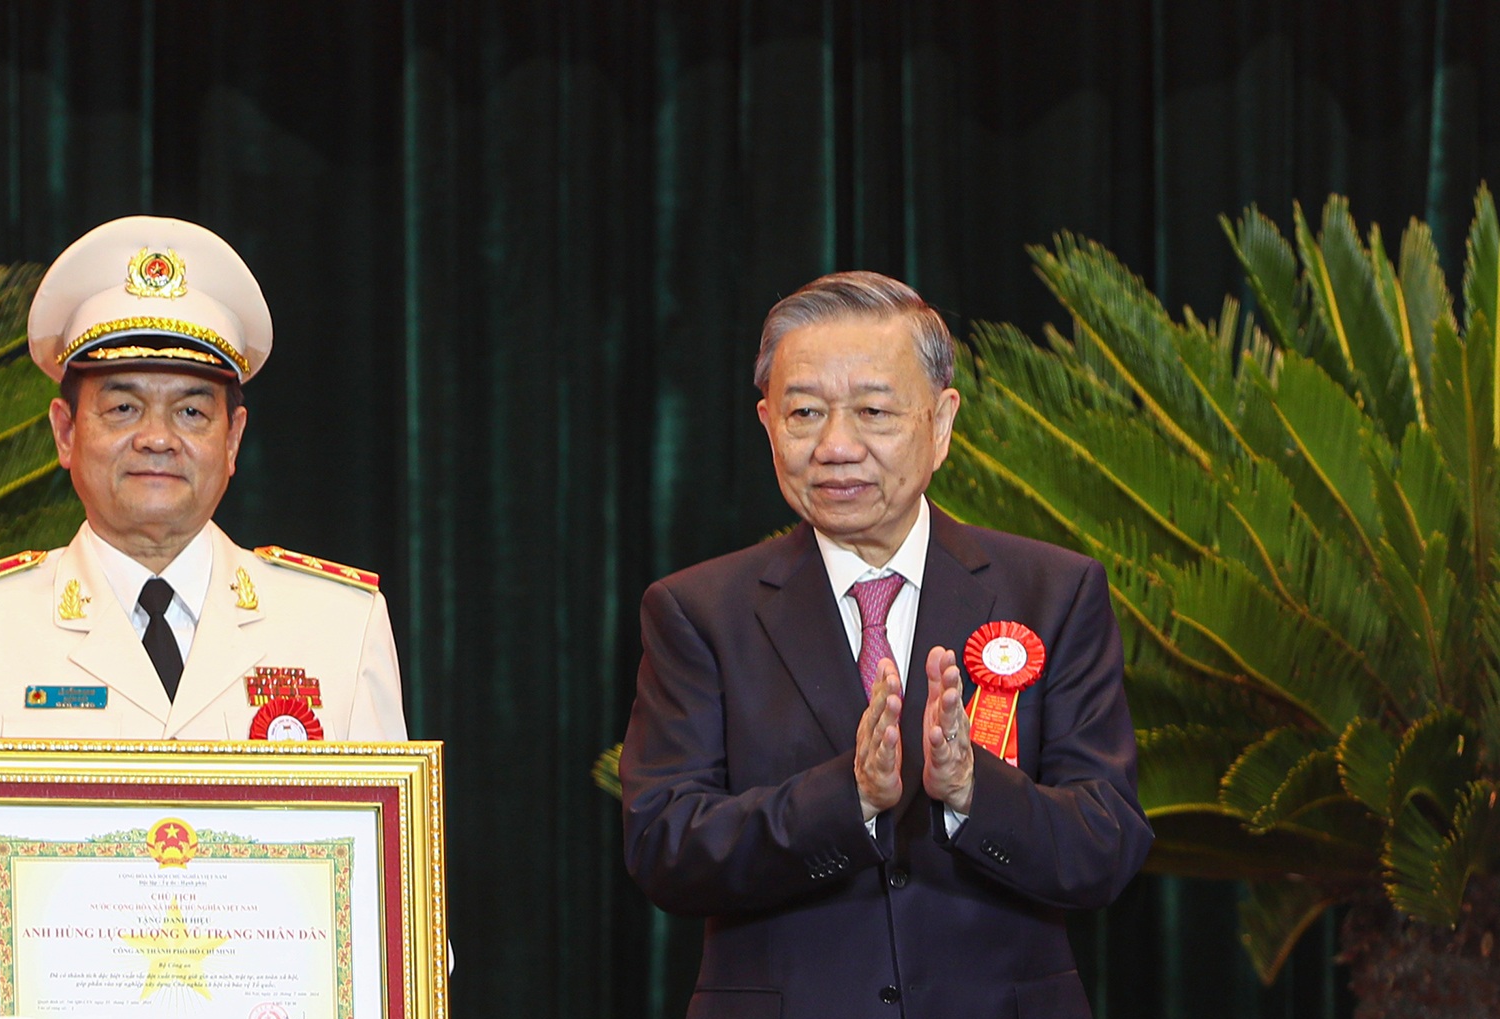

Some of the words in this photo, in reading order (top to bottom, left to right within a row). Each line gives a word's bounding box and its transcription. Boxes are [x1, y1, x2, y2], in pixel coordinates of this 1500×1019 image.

[22, 928, 52, 939] ANH
[55, 925, 94, 939] HÙNG
[98, 926, 127, 941] LỰC
[131, 926, 180, 942] LƯỢNG
[183, 926, 202, 940] VŨ
[204, 928, 253, 940] TRANG
[256, 926, 294, 940] NHÂN
[299, 926, 327, 940] DÂN
